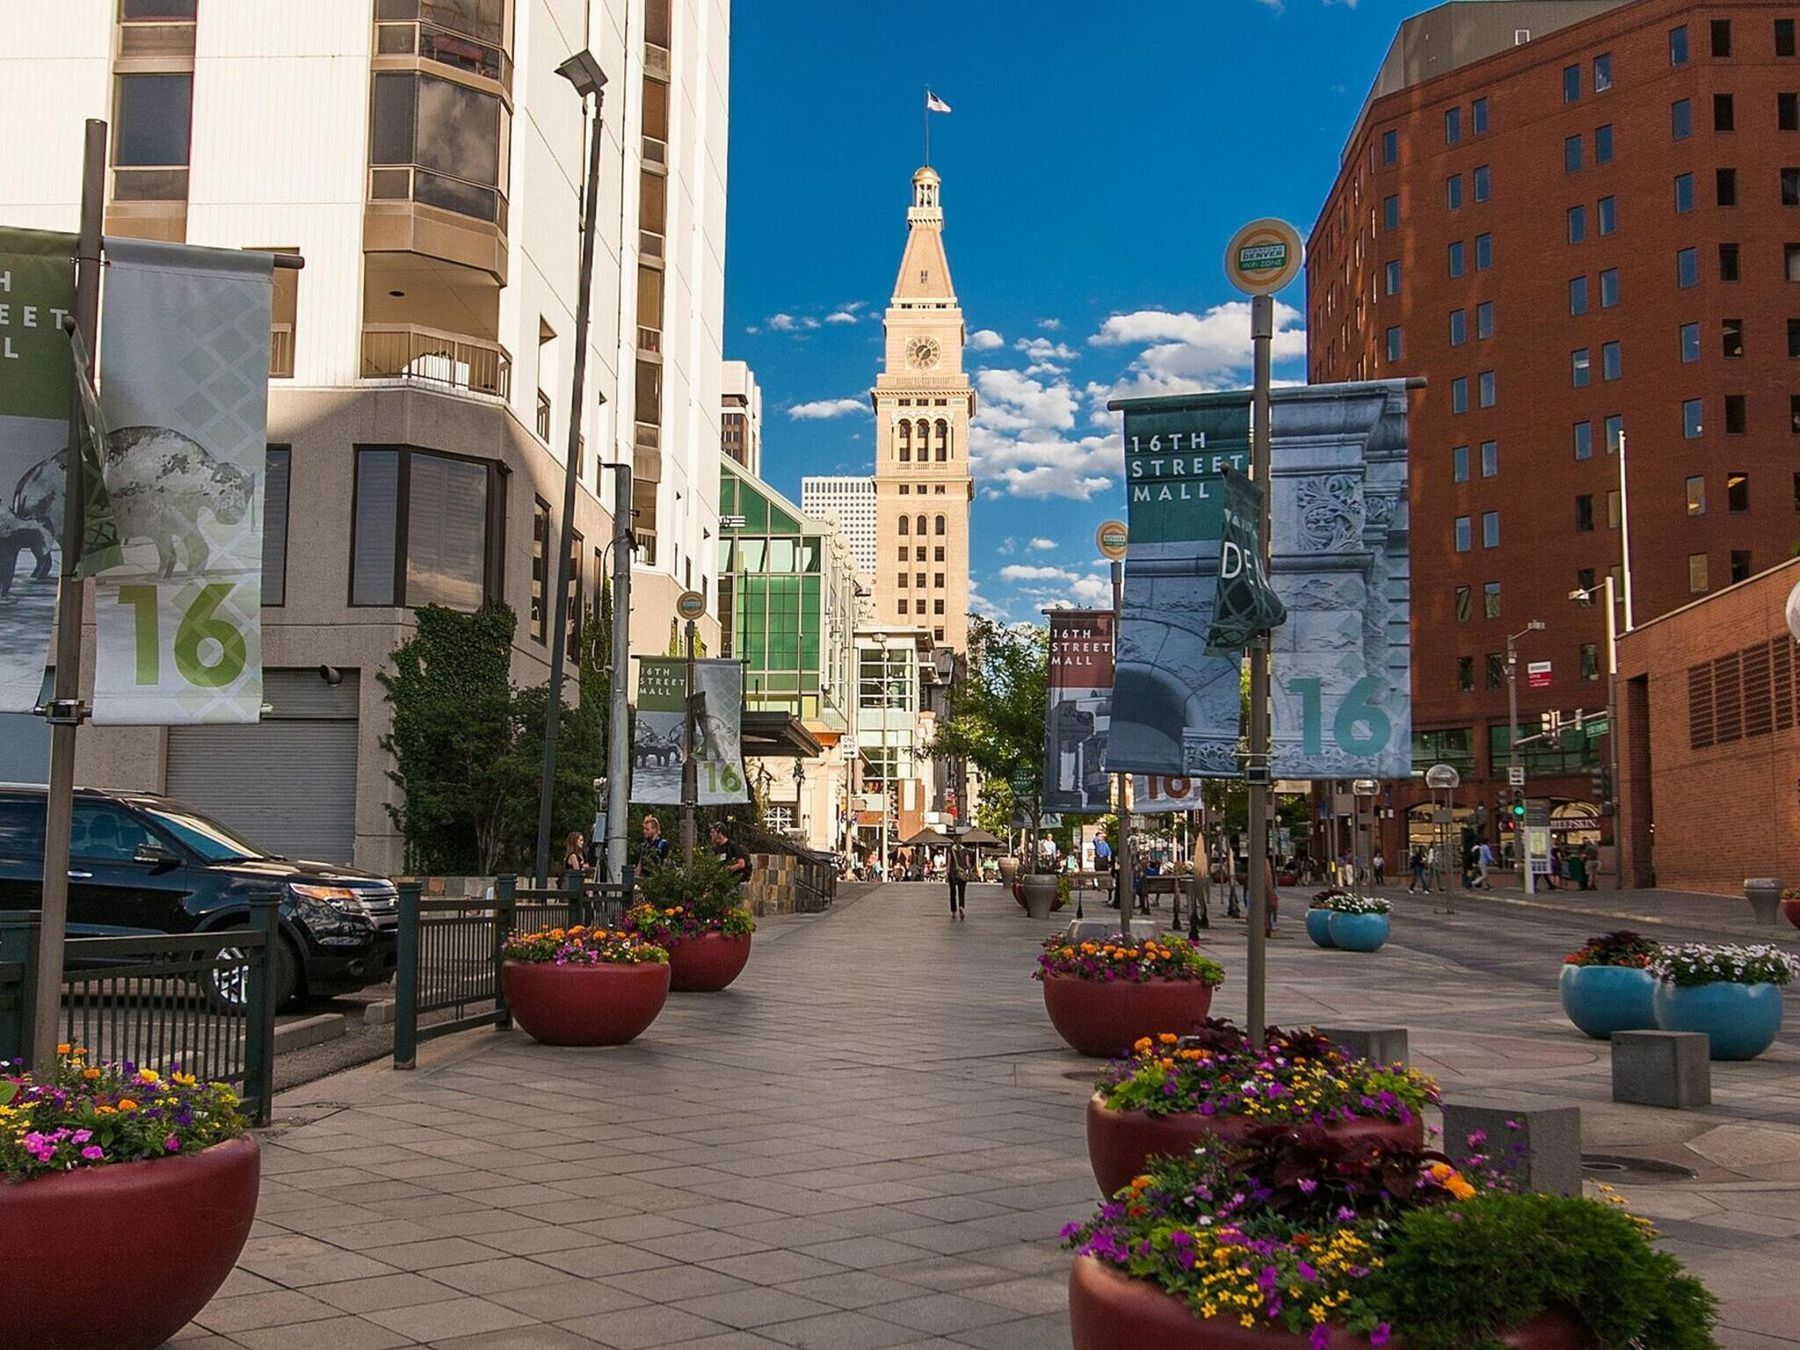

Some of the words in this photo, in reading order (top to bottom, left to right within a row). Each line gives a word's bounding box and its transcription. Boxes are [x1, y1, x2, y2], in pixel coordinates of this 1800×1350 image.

[0, 303, 69, 330] EET
[1131, 432, 1206, 453] 16TH
[1131, 455, 1243, 478] STREET
[1133, 483, 1210, 502] MALL
[1221, 541, 1271, 590] DEN
[117, 583, 246, 687] 16
[1053, 629, 1092, 639] 16TH
[1051, 643, 1110, 653] STREET
[1051, 656, 1093, 665] MALL
[641, 667, 670, 676] 16TH
[639, 678, 685, 686] STREET
[639, 687, 671, 696] MALL
[1288, 676, 1392, 756] 16
[703, 762, 741, 793] 16
